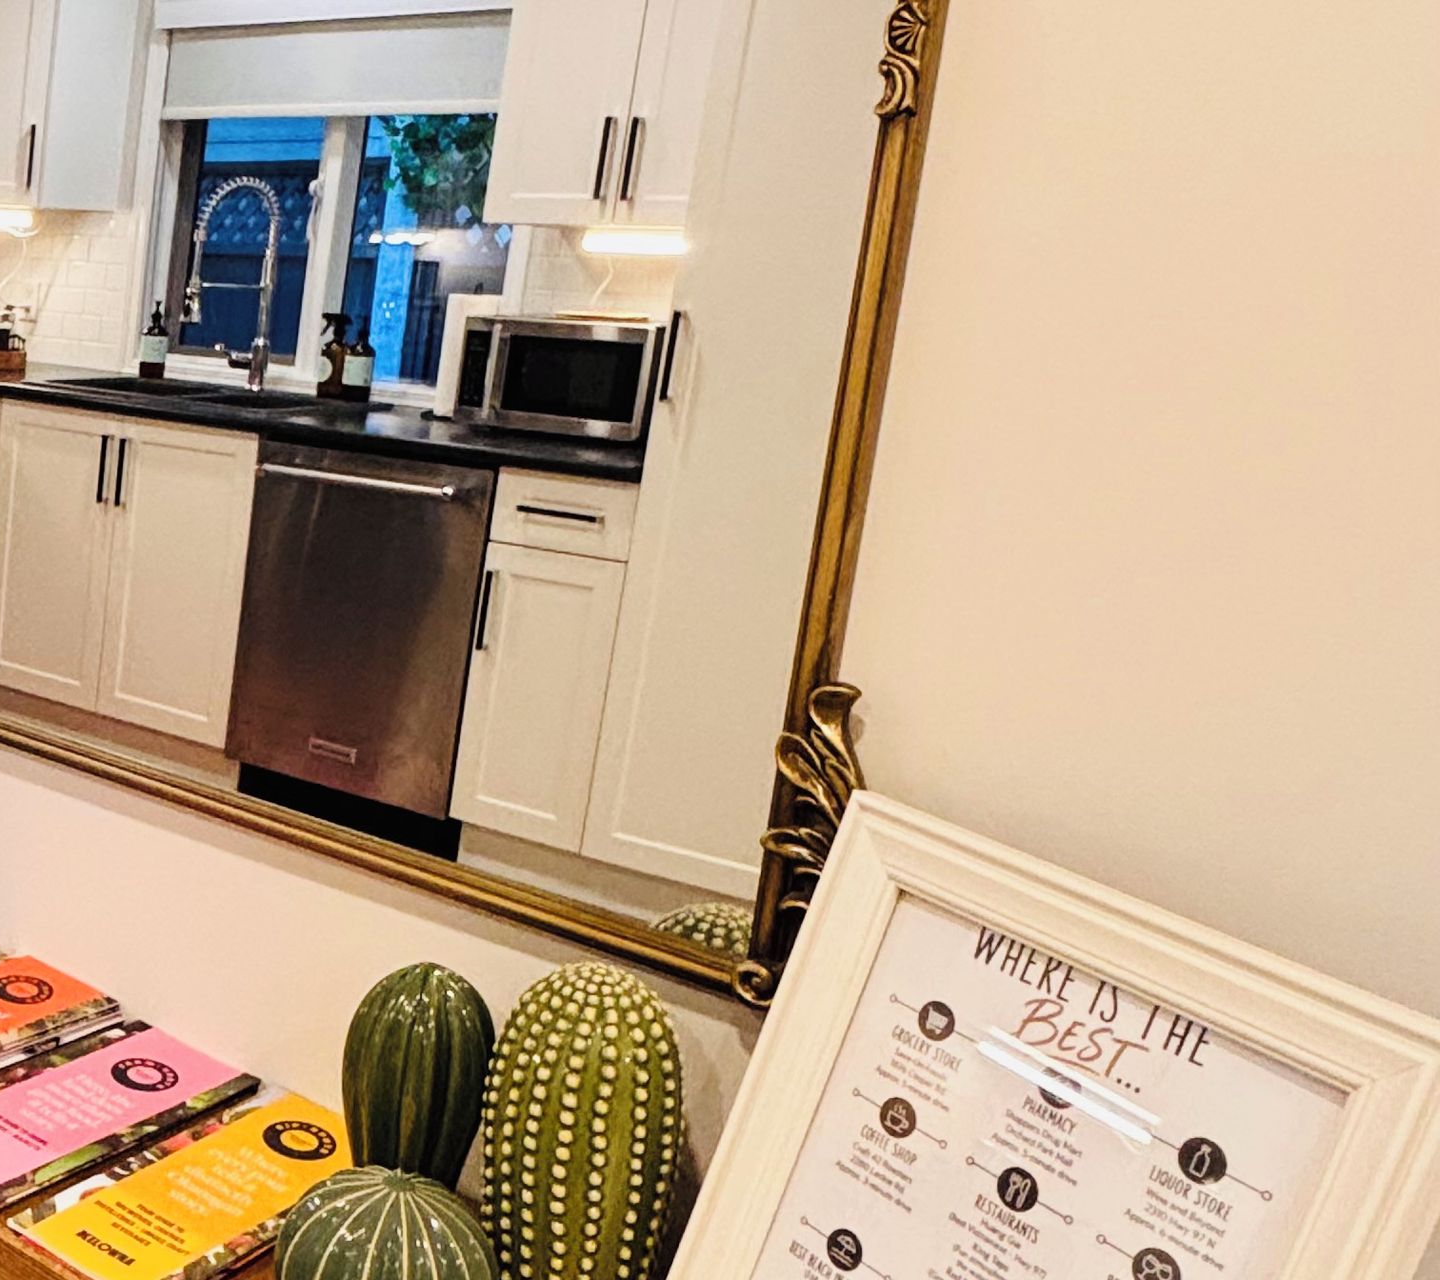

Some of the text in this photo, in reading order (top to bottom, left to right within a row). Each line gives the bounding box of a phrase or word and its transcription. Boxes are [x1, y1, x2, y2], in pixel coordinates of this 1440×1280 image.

[973, 927, 1079, 1004] WHERE
[1088, 979, 1120, 1023] IS
[889, 1023, 933, 1056] GROCERY
[932, 1046, 963, 1072] STORE
[1020, 1095, 1077, 1136] PHARMACY
[859, 1123, 918, 1168] COFFEE SHOP
[1146, 1165, 1234, 1222] LIQUOR STORE
[972, 1193, 1041, 1245] RESTAURANTS
[788, 1239, 808, 1262] BEST
[806, 1252, 834, 1280] BEACH
